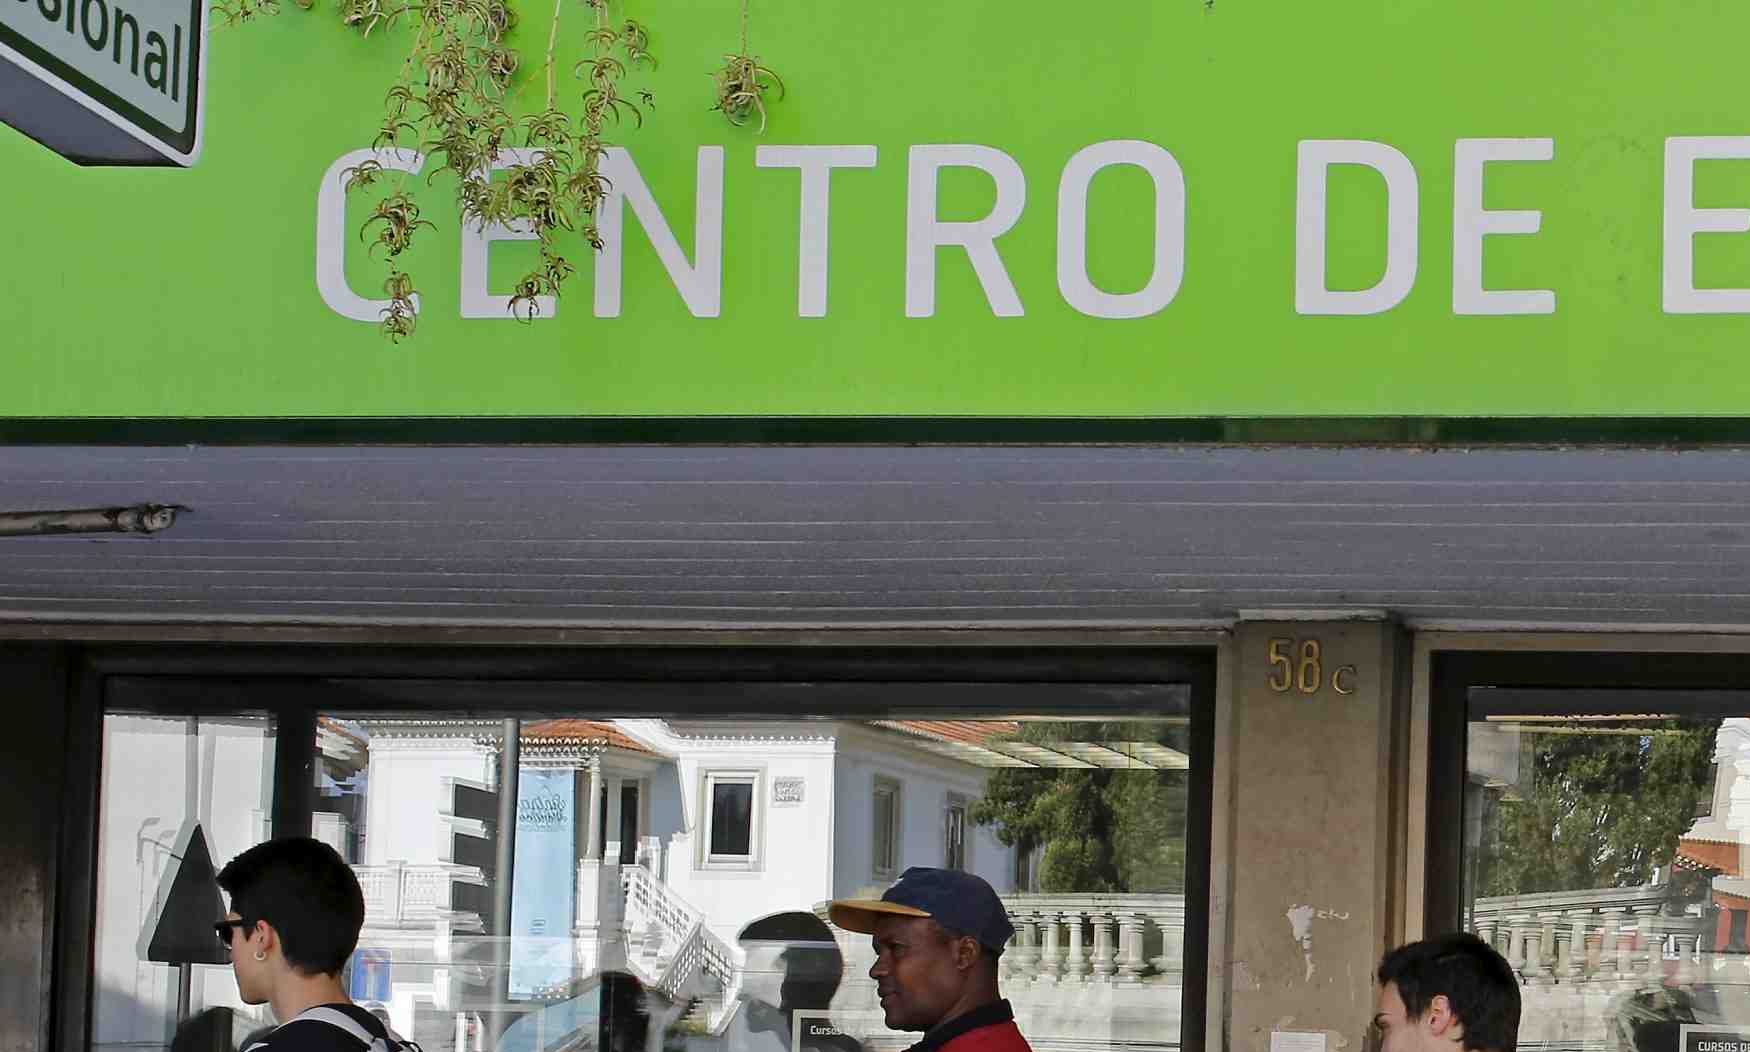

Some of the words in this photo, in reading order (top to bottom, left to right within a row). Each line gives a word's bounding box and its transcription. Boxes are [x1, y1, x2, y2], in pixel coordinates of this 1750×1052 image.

[315, 142, 1187, 322] CENTRO
[1295, 137, 1556, 318] DE
[1267, 638, 1322, 694] 58
[1698, 1041, 1738, 1052] CURSOS
